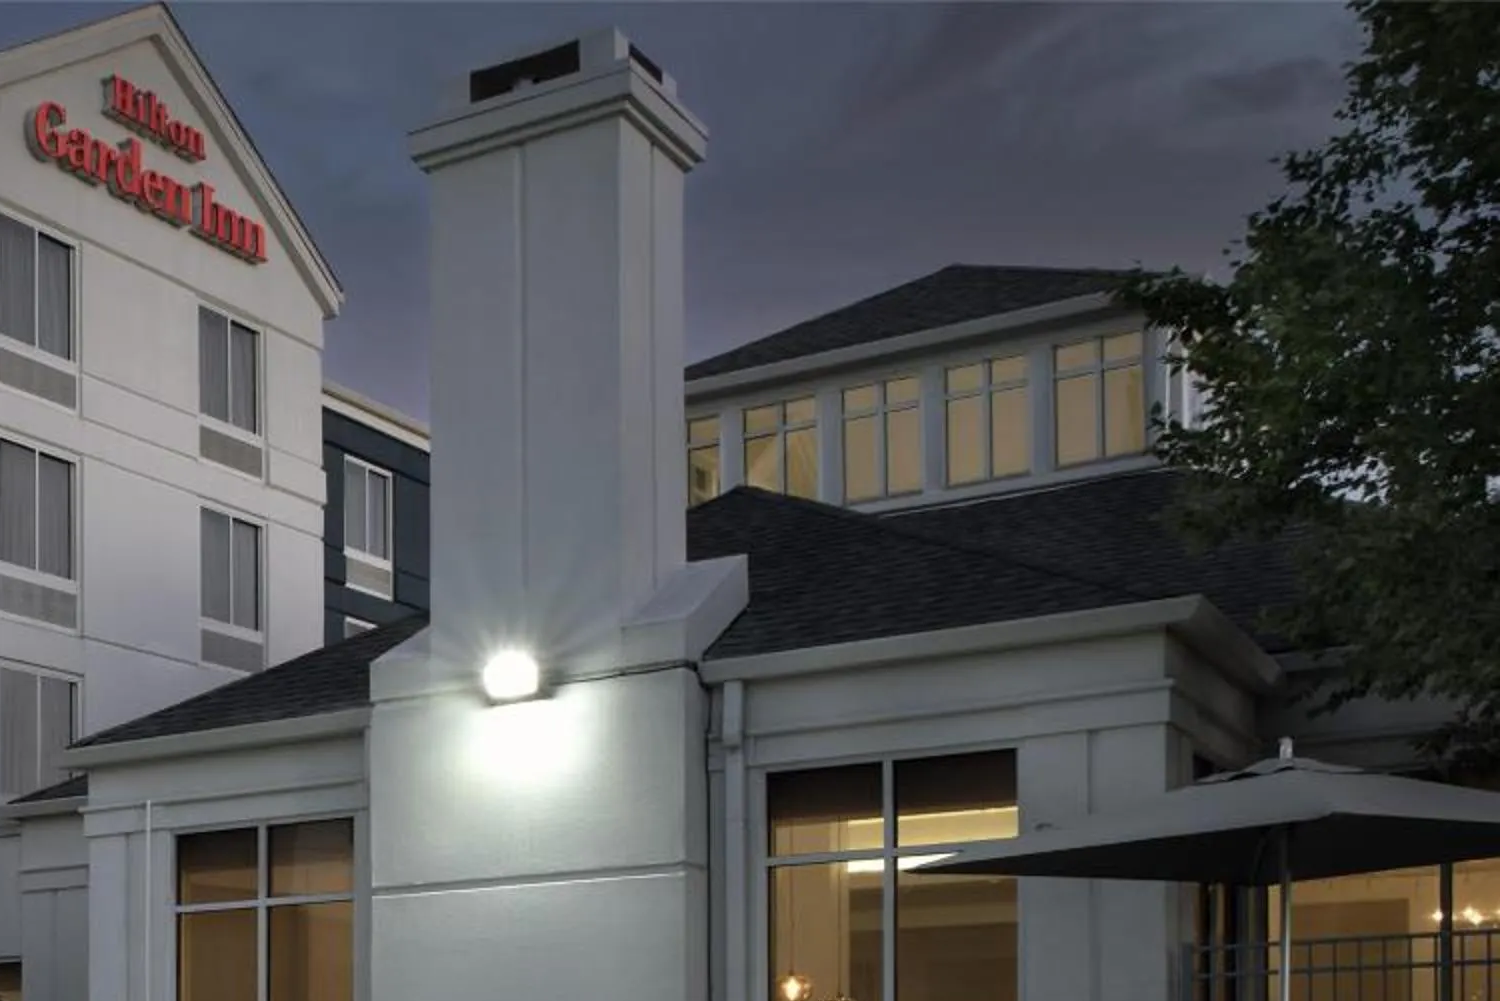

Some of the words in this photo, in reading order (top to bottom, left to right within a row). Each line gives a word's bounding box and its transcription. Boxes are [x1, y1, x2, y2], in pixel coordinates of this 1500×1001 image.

[104, 72, 206, 162] Hilton
[28, 100, 192, 227] Garden
[194, 181, 268, 264] Inn
